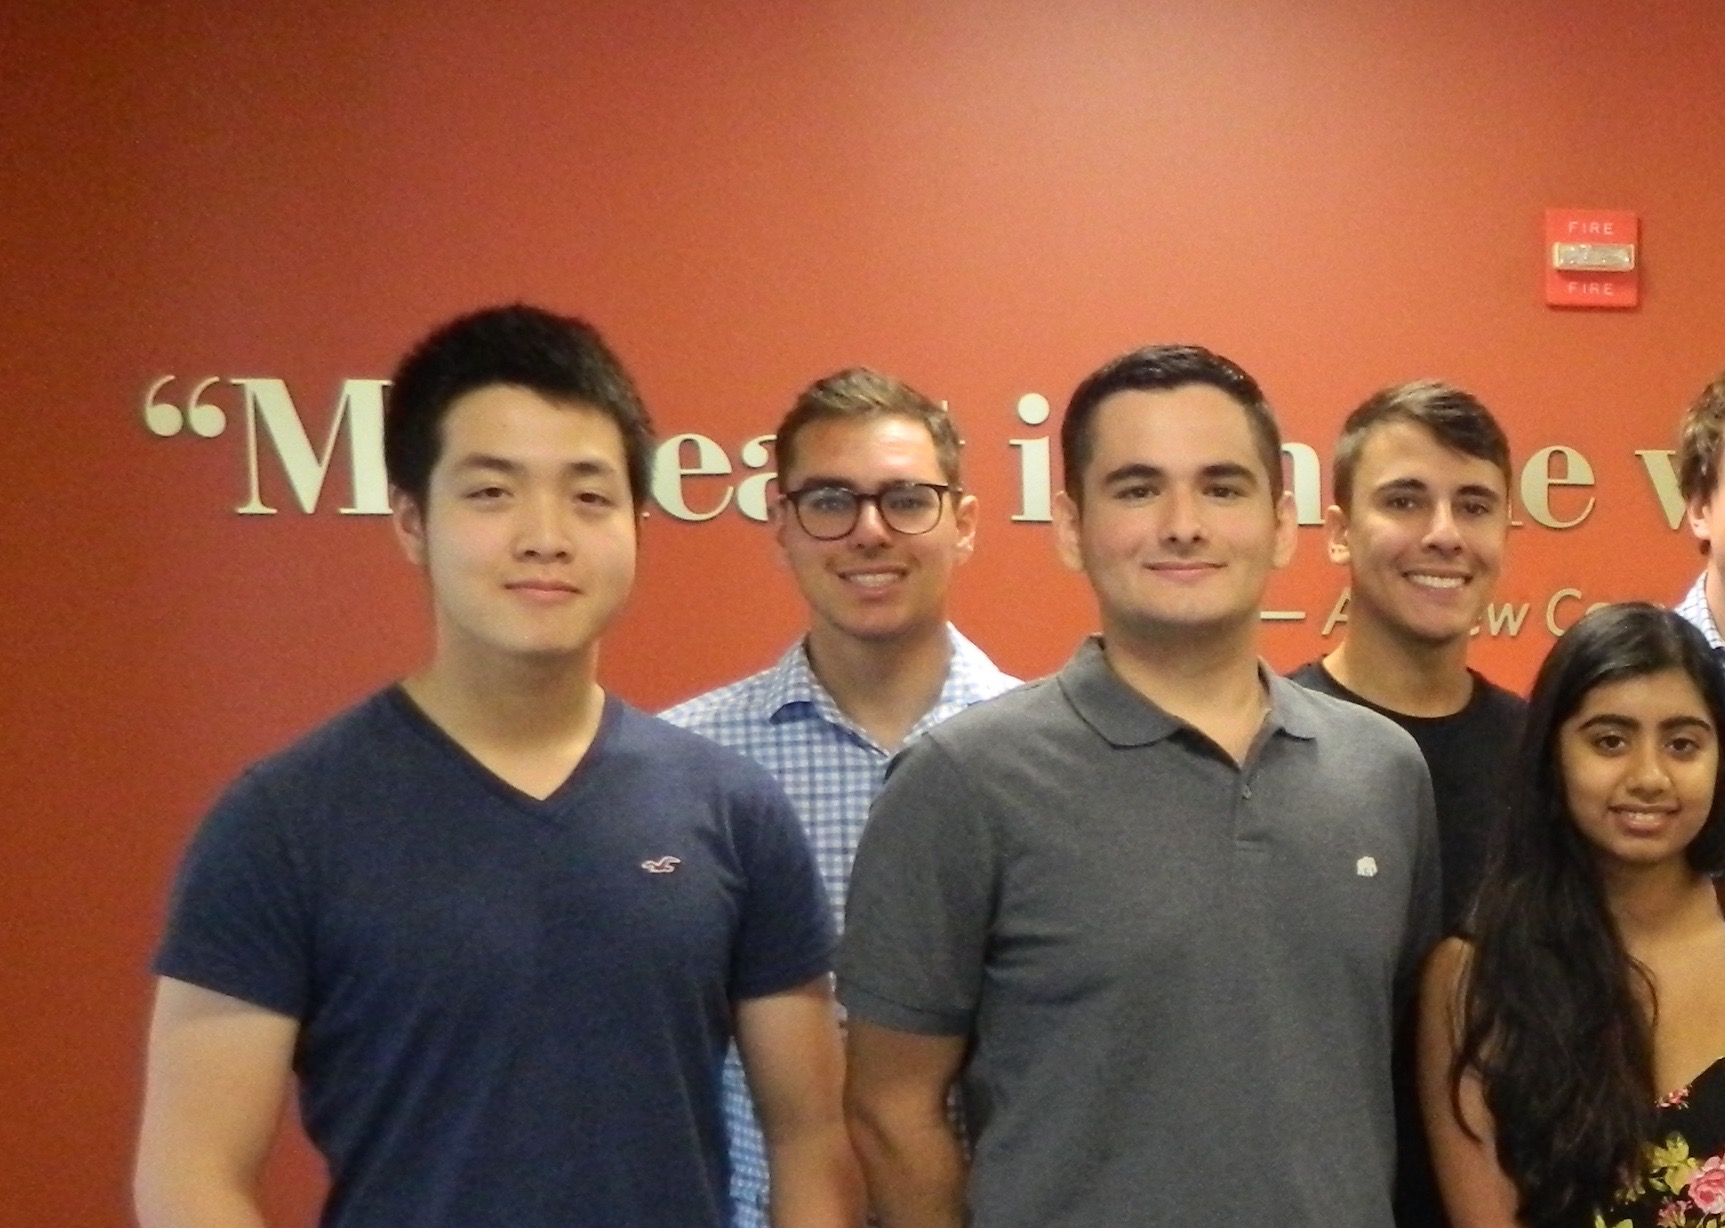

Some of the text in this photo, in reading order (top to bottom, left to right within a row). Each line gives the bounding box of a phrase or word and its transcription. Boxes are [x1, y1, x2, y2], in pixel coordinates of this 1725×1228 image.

[1568, 221, 1614, 235] FIRE
[1568, 282, 1614, 296] FIRE
[145, 375, 394, 515] “M
[1008, 392, 1054, 521] i
